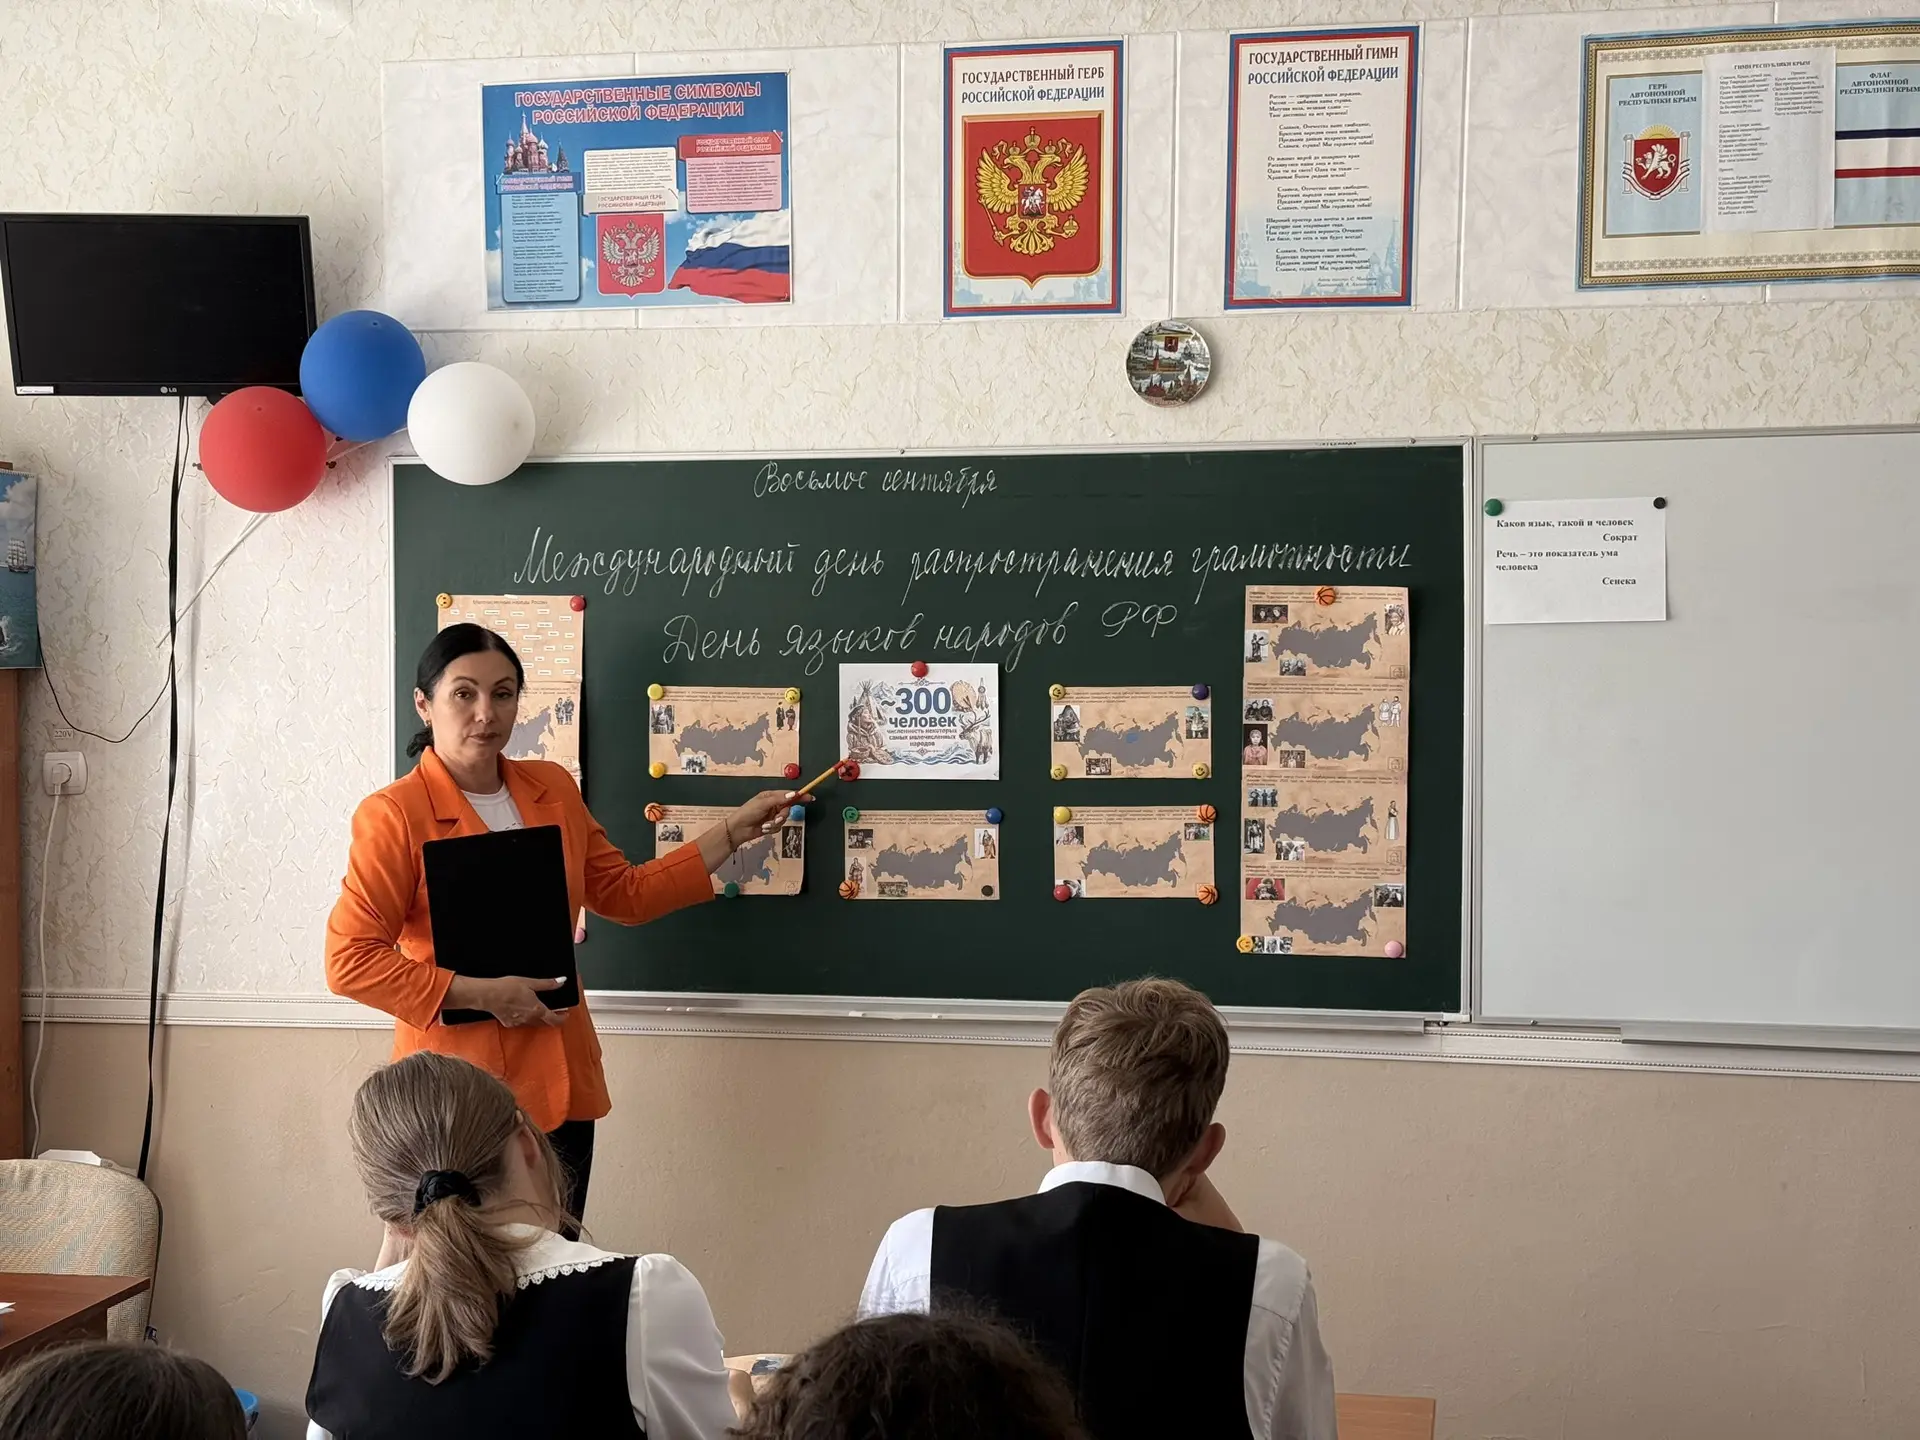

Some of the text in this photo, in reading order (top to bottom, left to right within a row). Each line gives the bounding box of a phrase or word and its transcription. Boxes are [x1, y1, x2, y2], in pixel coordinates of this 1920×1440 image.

[1249, 44, 1399, 66] ГОСУДАРСТВЕННЫЙ ГИМН
[962, 64, 1105, 86] ГОСУДАРСТВЕННЫЙ ГЕРБ
[1248, 65, 1399, 85] РОССИЙСКОЙ ФЕДЕРАЦИИ
[1648, 83, 1668, 91] ГЕРБ
[1851, 78, 1909, 87] АВТОНОМНОЙ
[515, 82, 761, 108] ГОСУДАРСТВЕННЫЕ СИМВОЛЫ
[961, 85, 1105, 103] РОССИЙСКОЙ ФЕДЕРАЦИИ
[1629, 89, 1686, 98] АВТОНОМНОЙ
[1840, 86, 1895, 95] РЕСПУБЛИКИ
[1618, 96, 1697, 106] РЕСПУБЛИКИ КРЫМ
[532, 101, 744, 125] РОССИЙСКОЙ ФЕДЕРАЦИИ
[753, 461, 999, 509] Восьмое сентября
[1496, 519, 1526, 528] Каков
[1528, 520, 1555, 529] язык,
[1557, 518, 1585, 528] такой
[1596, 518, 1634, 527] человек
[1602, 533, 1638, 543] Сократ
[1496, 550, 1518, 558] Речь
[1528, 550, 1543, 558] это
[1545, 550, 1598, 558] показатель
[1601, 550, 1618, 559] ума
[513, 526, 1414, 606] Международный день распространения грамотности
[1496, 564, 1538, 572] человека
[1602, 577, 1637, 585] Сенека
[662, 601, 1178, 676] День языков народов РФ
[889, 716, 957, 728] человек
